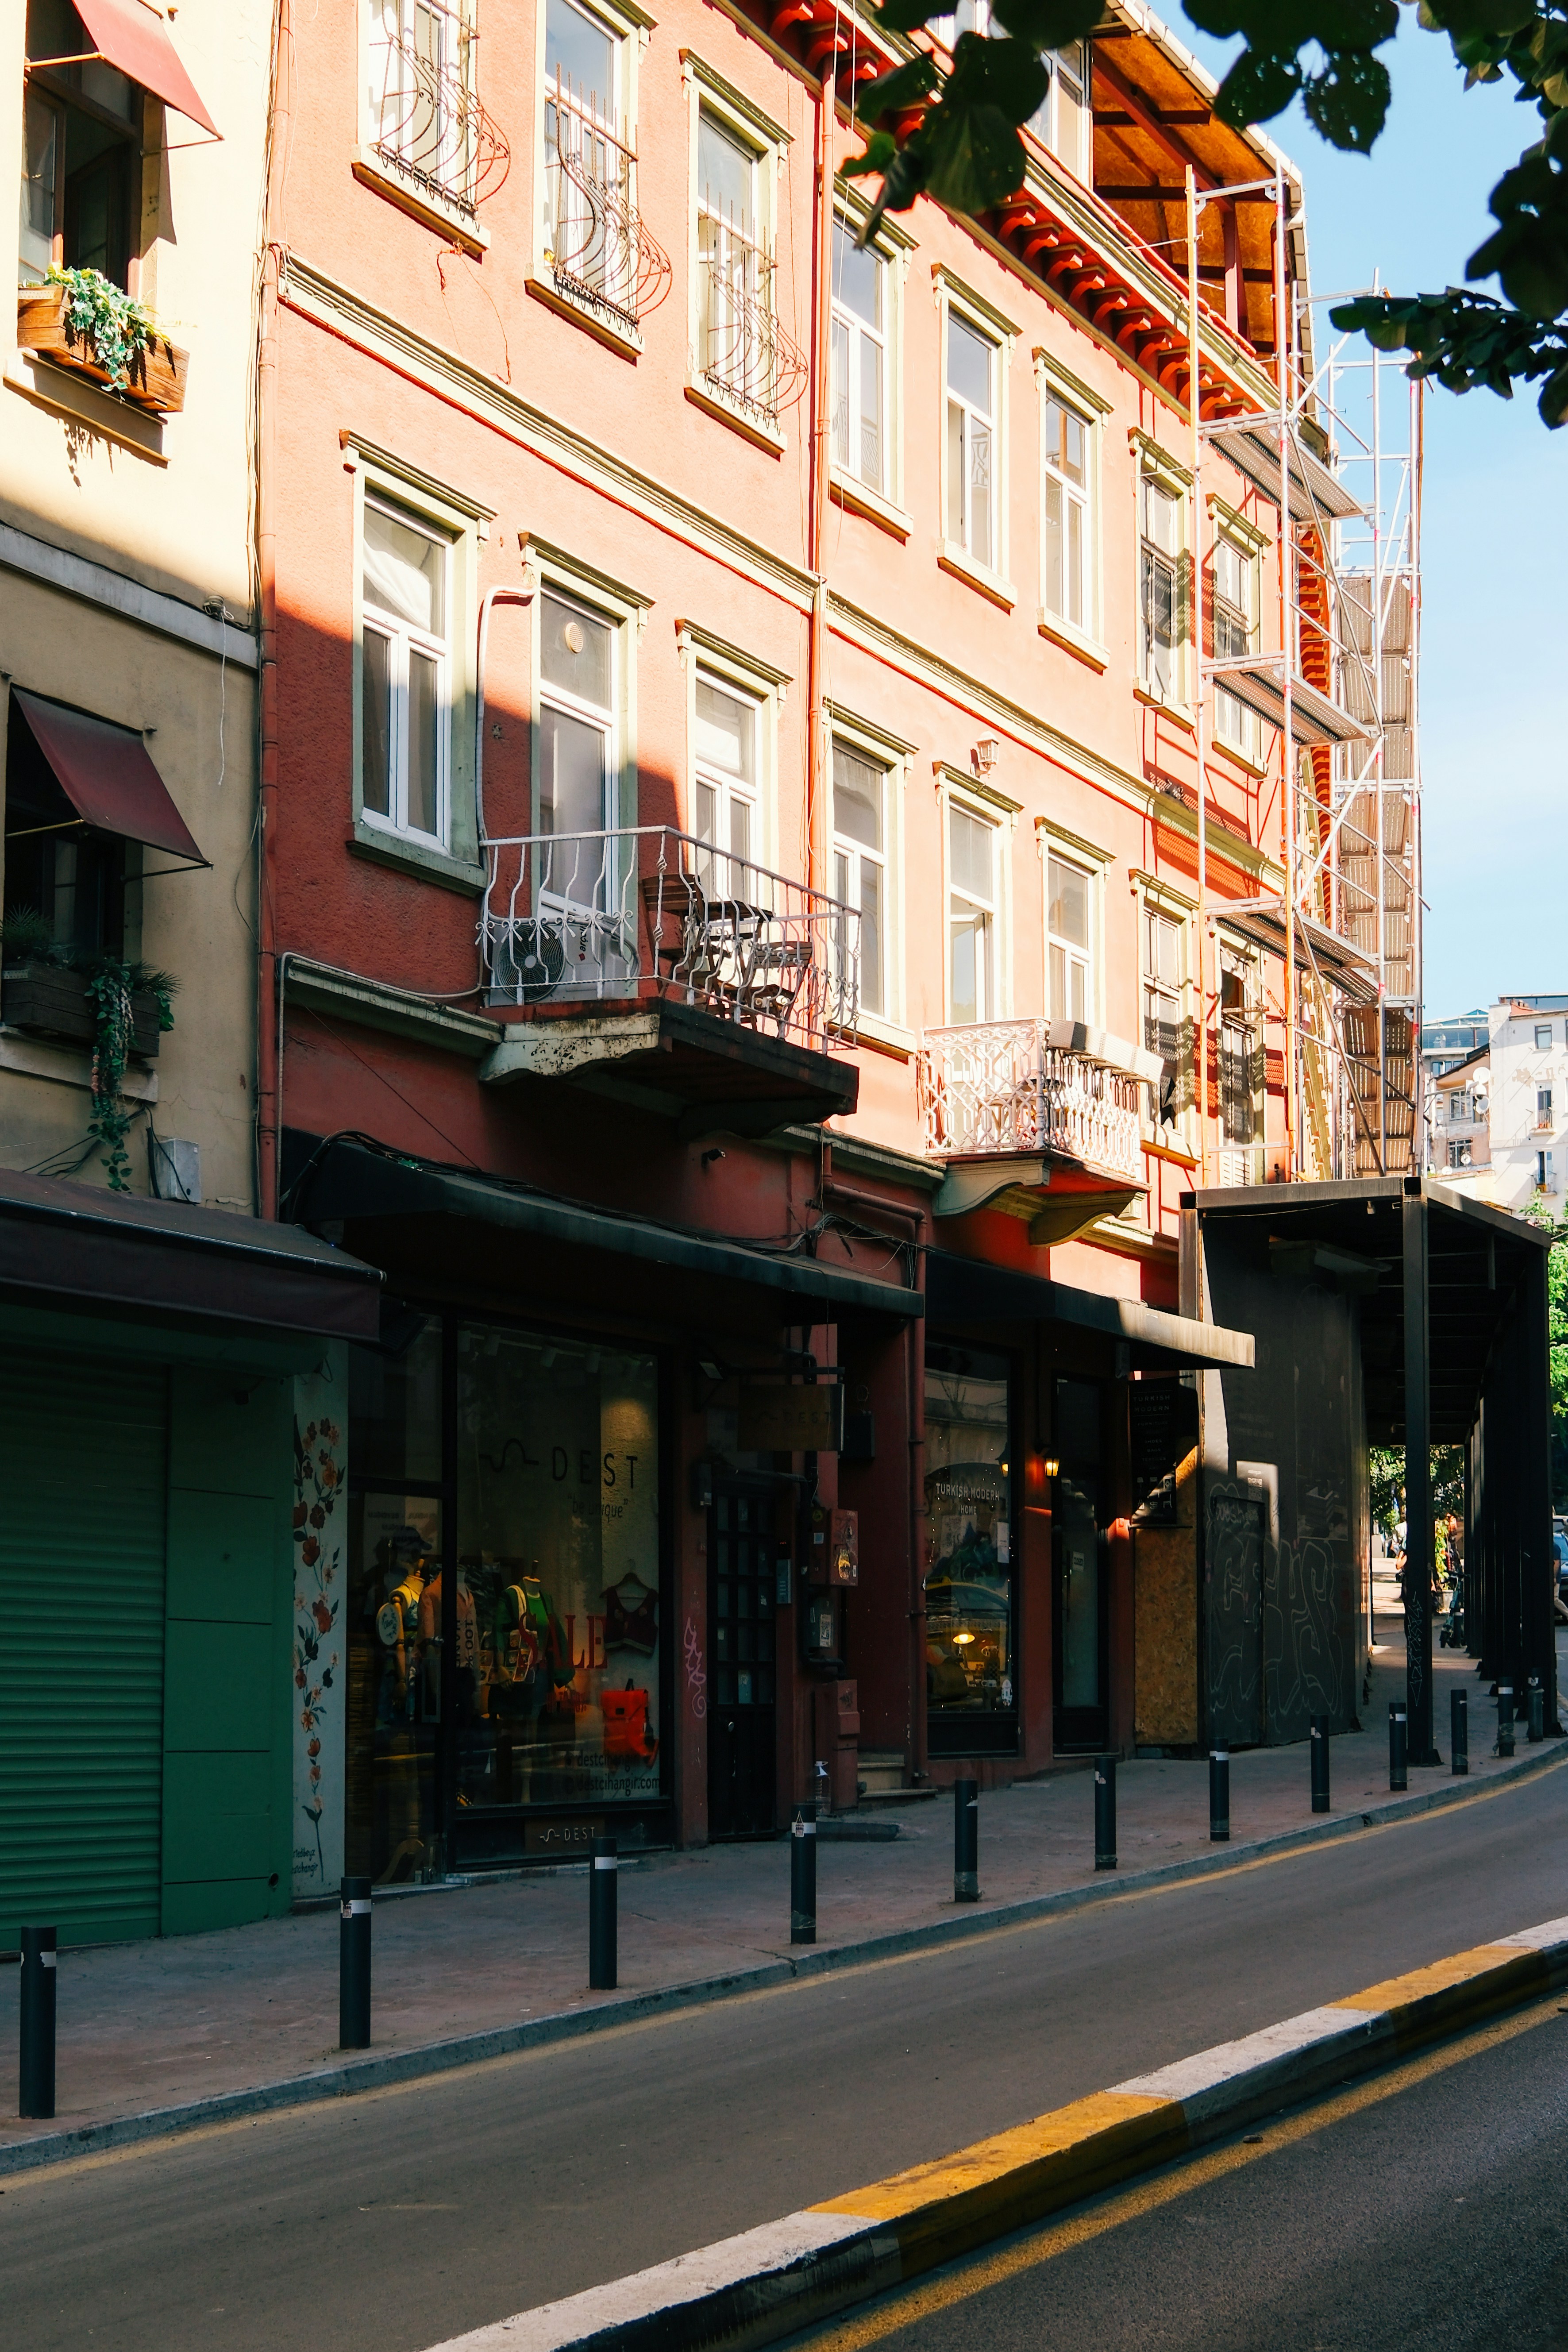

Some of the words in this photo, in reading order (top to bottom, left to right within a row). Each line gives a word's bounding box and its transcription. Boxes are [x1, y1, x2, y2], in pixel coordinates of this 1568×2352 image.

[784, 1411, 830, 1423] DEST
[552, 1446, 638, 1489] DEST
[936, 1482, 968, 1498] TURKISH
[971, 1487, 1000, 1501] MODERN
[960, 1504, 977, 1515] HOME
[518, 1612, 608, 1669] SALE
[564, 1827, 595, 1842] DEST
